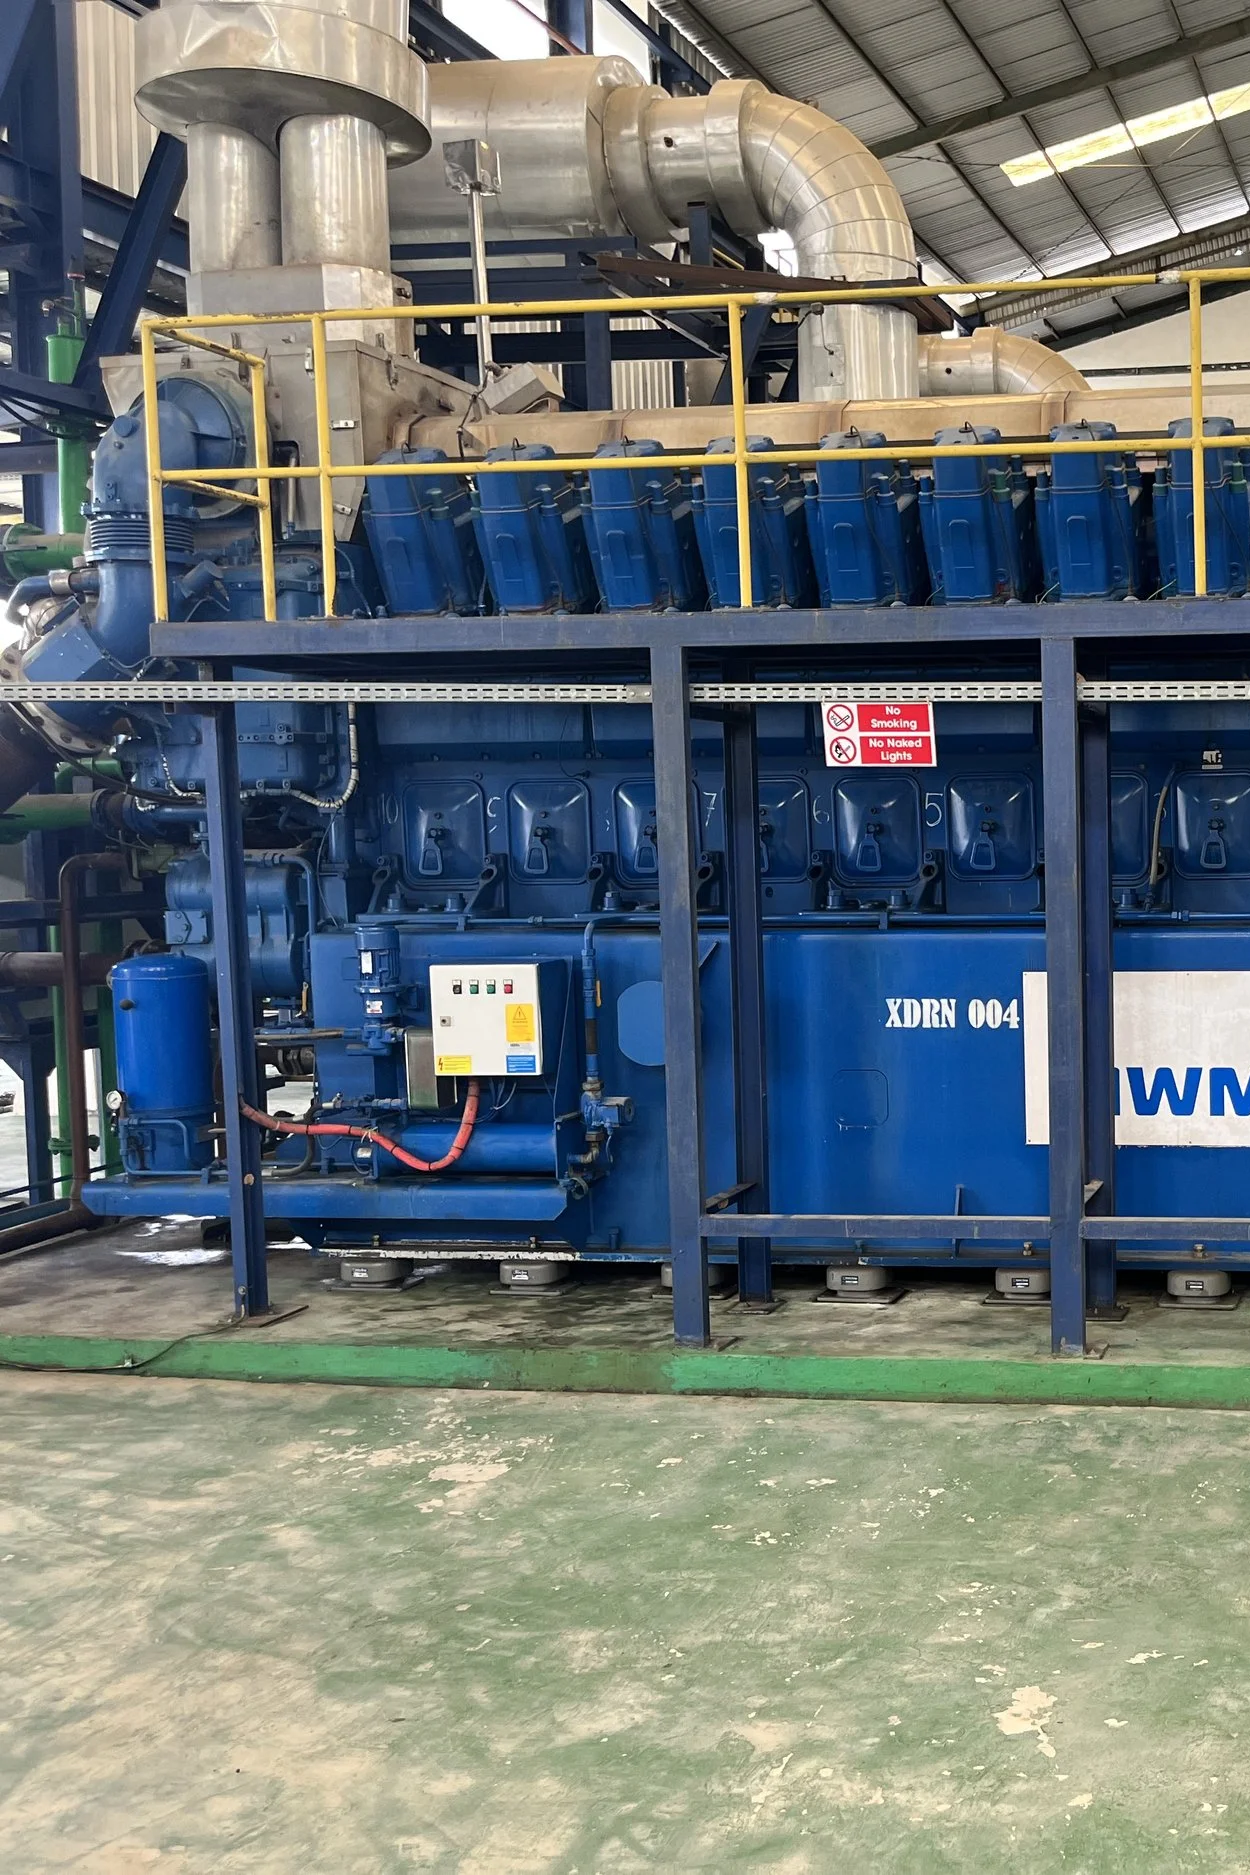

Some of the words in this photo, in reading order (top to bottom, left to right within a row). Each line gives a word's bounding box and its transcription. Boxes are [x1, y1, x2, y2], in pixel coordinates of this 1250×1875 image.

[885, 706, 901, 715] No
[870, 718, 917, 730] Smoking
[869, 738, 884, 748] No
[887, 738, 922, 748] Naked
[880, 751, 912, 763] Lights
[703, 792, 717, 827] 7
[925, 793, 943, 827] 5
[885, 998, 957, 1028] XDRN
[968, 998, 1020, 1029] 004
